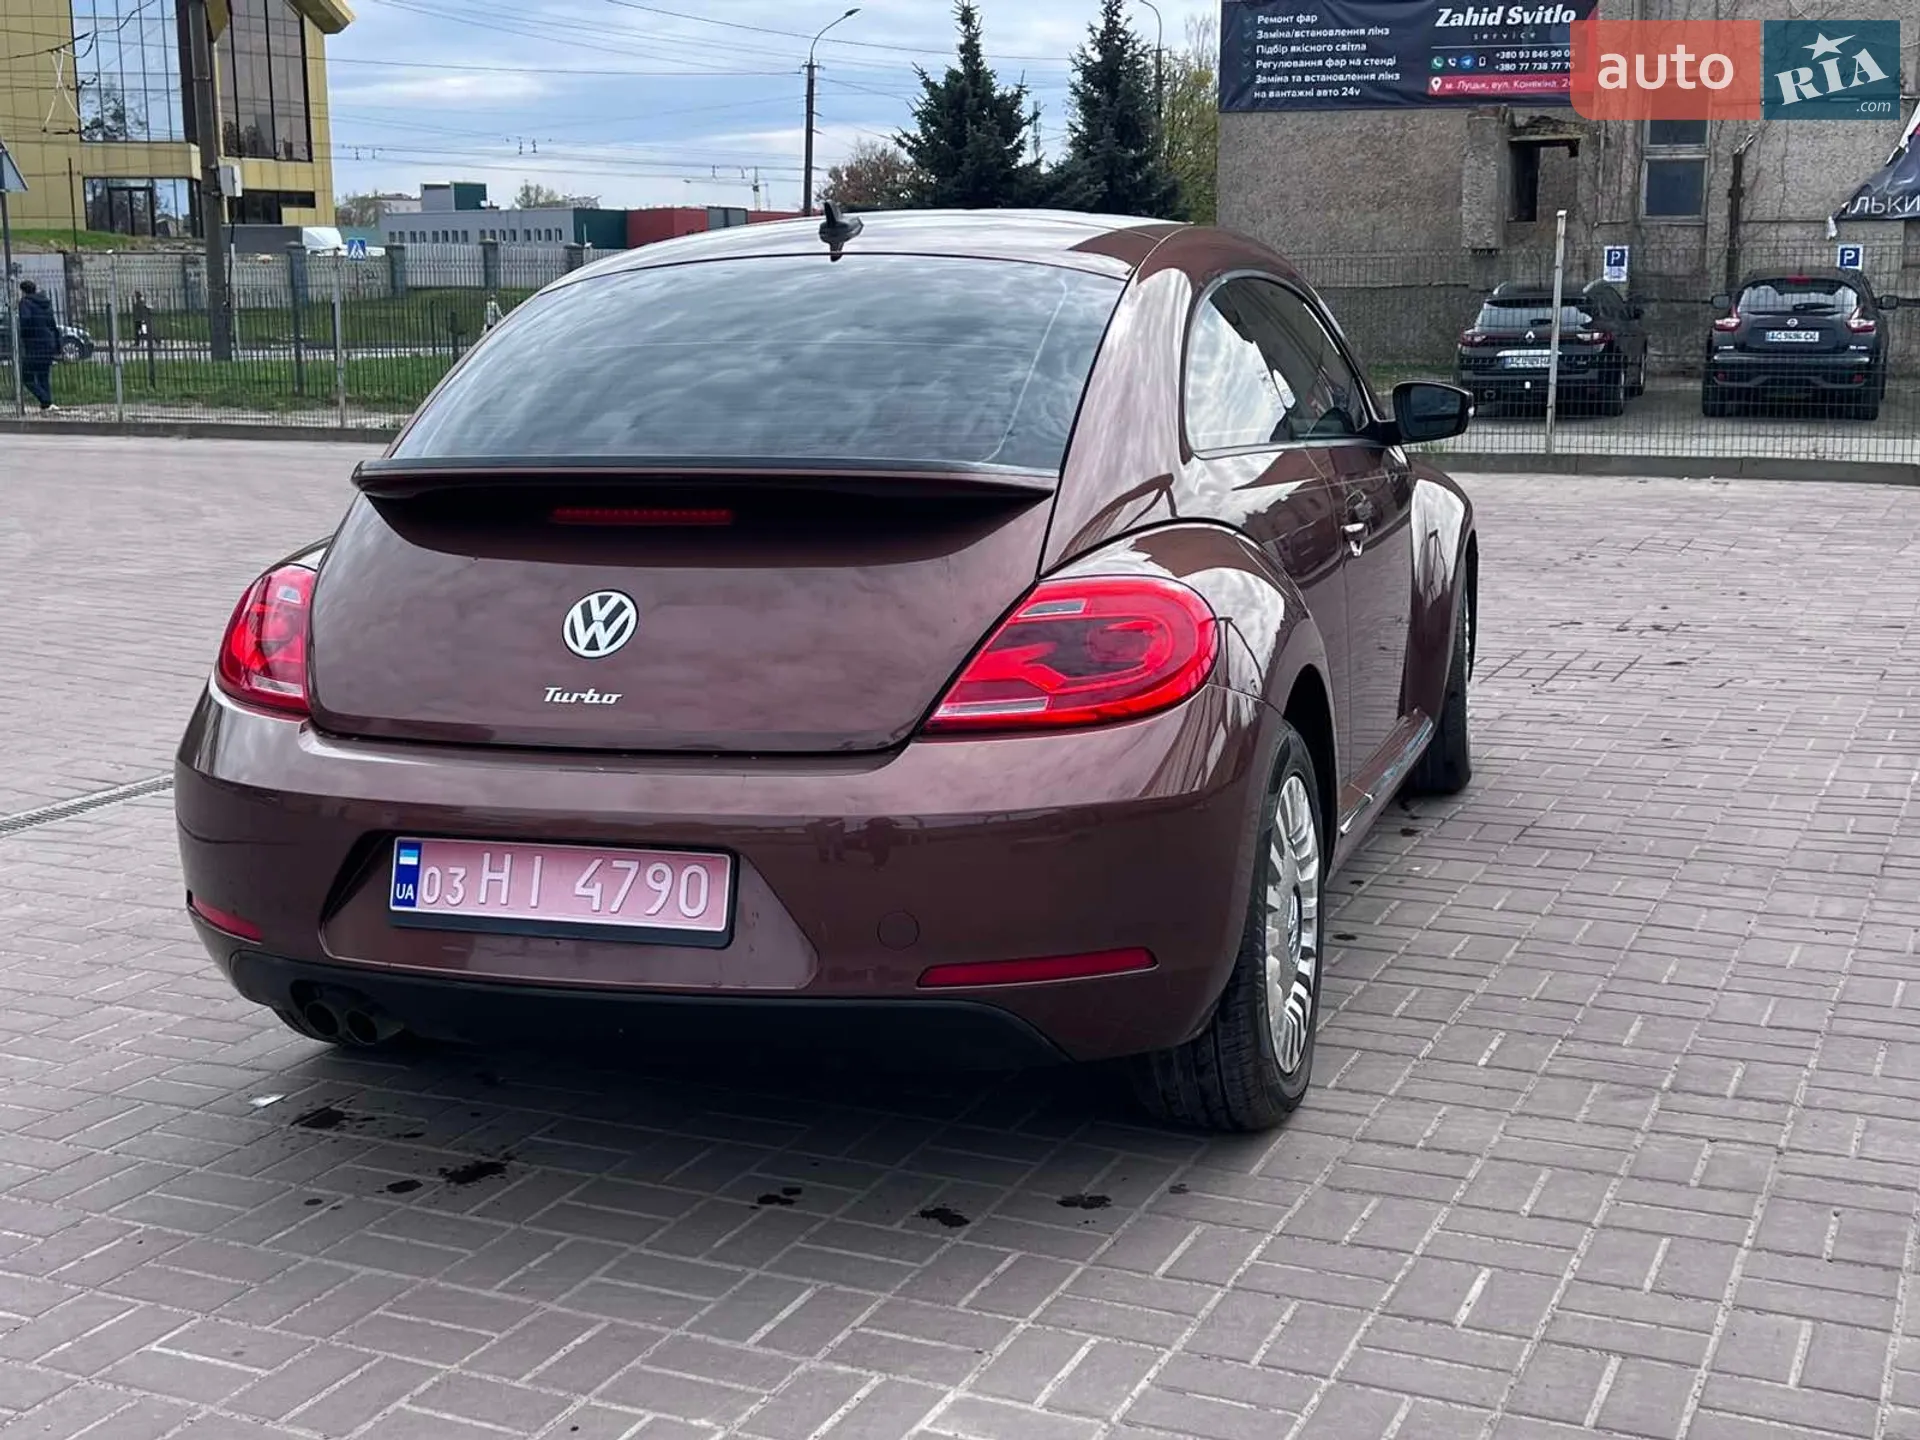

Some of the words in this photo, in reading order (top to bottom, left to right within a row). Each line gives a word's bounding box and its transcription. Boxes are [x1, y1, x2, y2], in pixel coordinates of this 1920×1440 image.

[1257, 14, 1294, 24] Ремонт
[1296, 13, 1318, 25] фар
[1435, 6, 1503, 27] Zahid
[1506, 4, 1576, 25] Svitlo
[1367, 26, 1390, 36] лінз
[1256, 44, 1288, 55] Підбір
[1290, 43, 1334, 53] якісного
[1335, 41, 1367, 52] світла
[1494, 50, 1517, 59] +380
[1518, 50, 1530, 59] 93
[1532, 49, 1549, 59] 846
[1550, 49, 1562, 58] 90
[1255, 58, 1323, 70] Регулювання
[1324, 57, 1347, 69] фар
[1348, 58, 1361, 66] на
[1363, 55, 1396, 67] стенді
[1494, 62, 1517, 71] +380
[1519, 62, 1531, 71] 77
[1532, 61, 1548, 71] 738
[1550, 61, 1562, 71] 77
[1563, 61, 1576, 70] 70
[1255, 73, 1289, 84] Заміна
[1291, 74, 1302, 83] та
[1304, 72, 1376, 83] встановлення
[1377, 70, 1400, 81] лінз
[1254, 89, 1266, 99] на
[1268, 87, 1314, 98] вантажні
[1316, 88, 1339, 97] авто
[1611, 250, 1621, 265] P
[1843, 249, 1856, 265] P
[566, 591, 635, 656] VW
[543, 686, 624, 705] Turbo
[396, 884, 415, 900] UA
[421, 865, 467, 906] 03
[478, 852, 543, 908] HI
[574, 857, 710, 919] 4790
